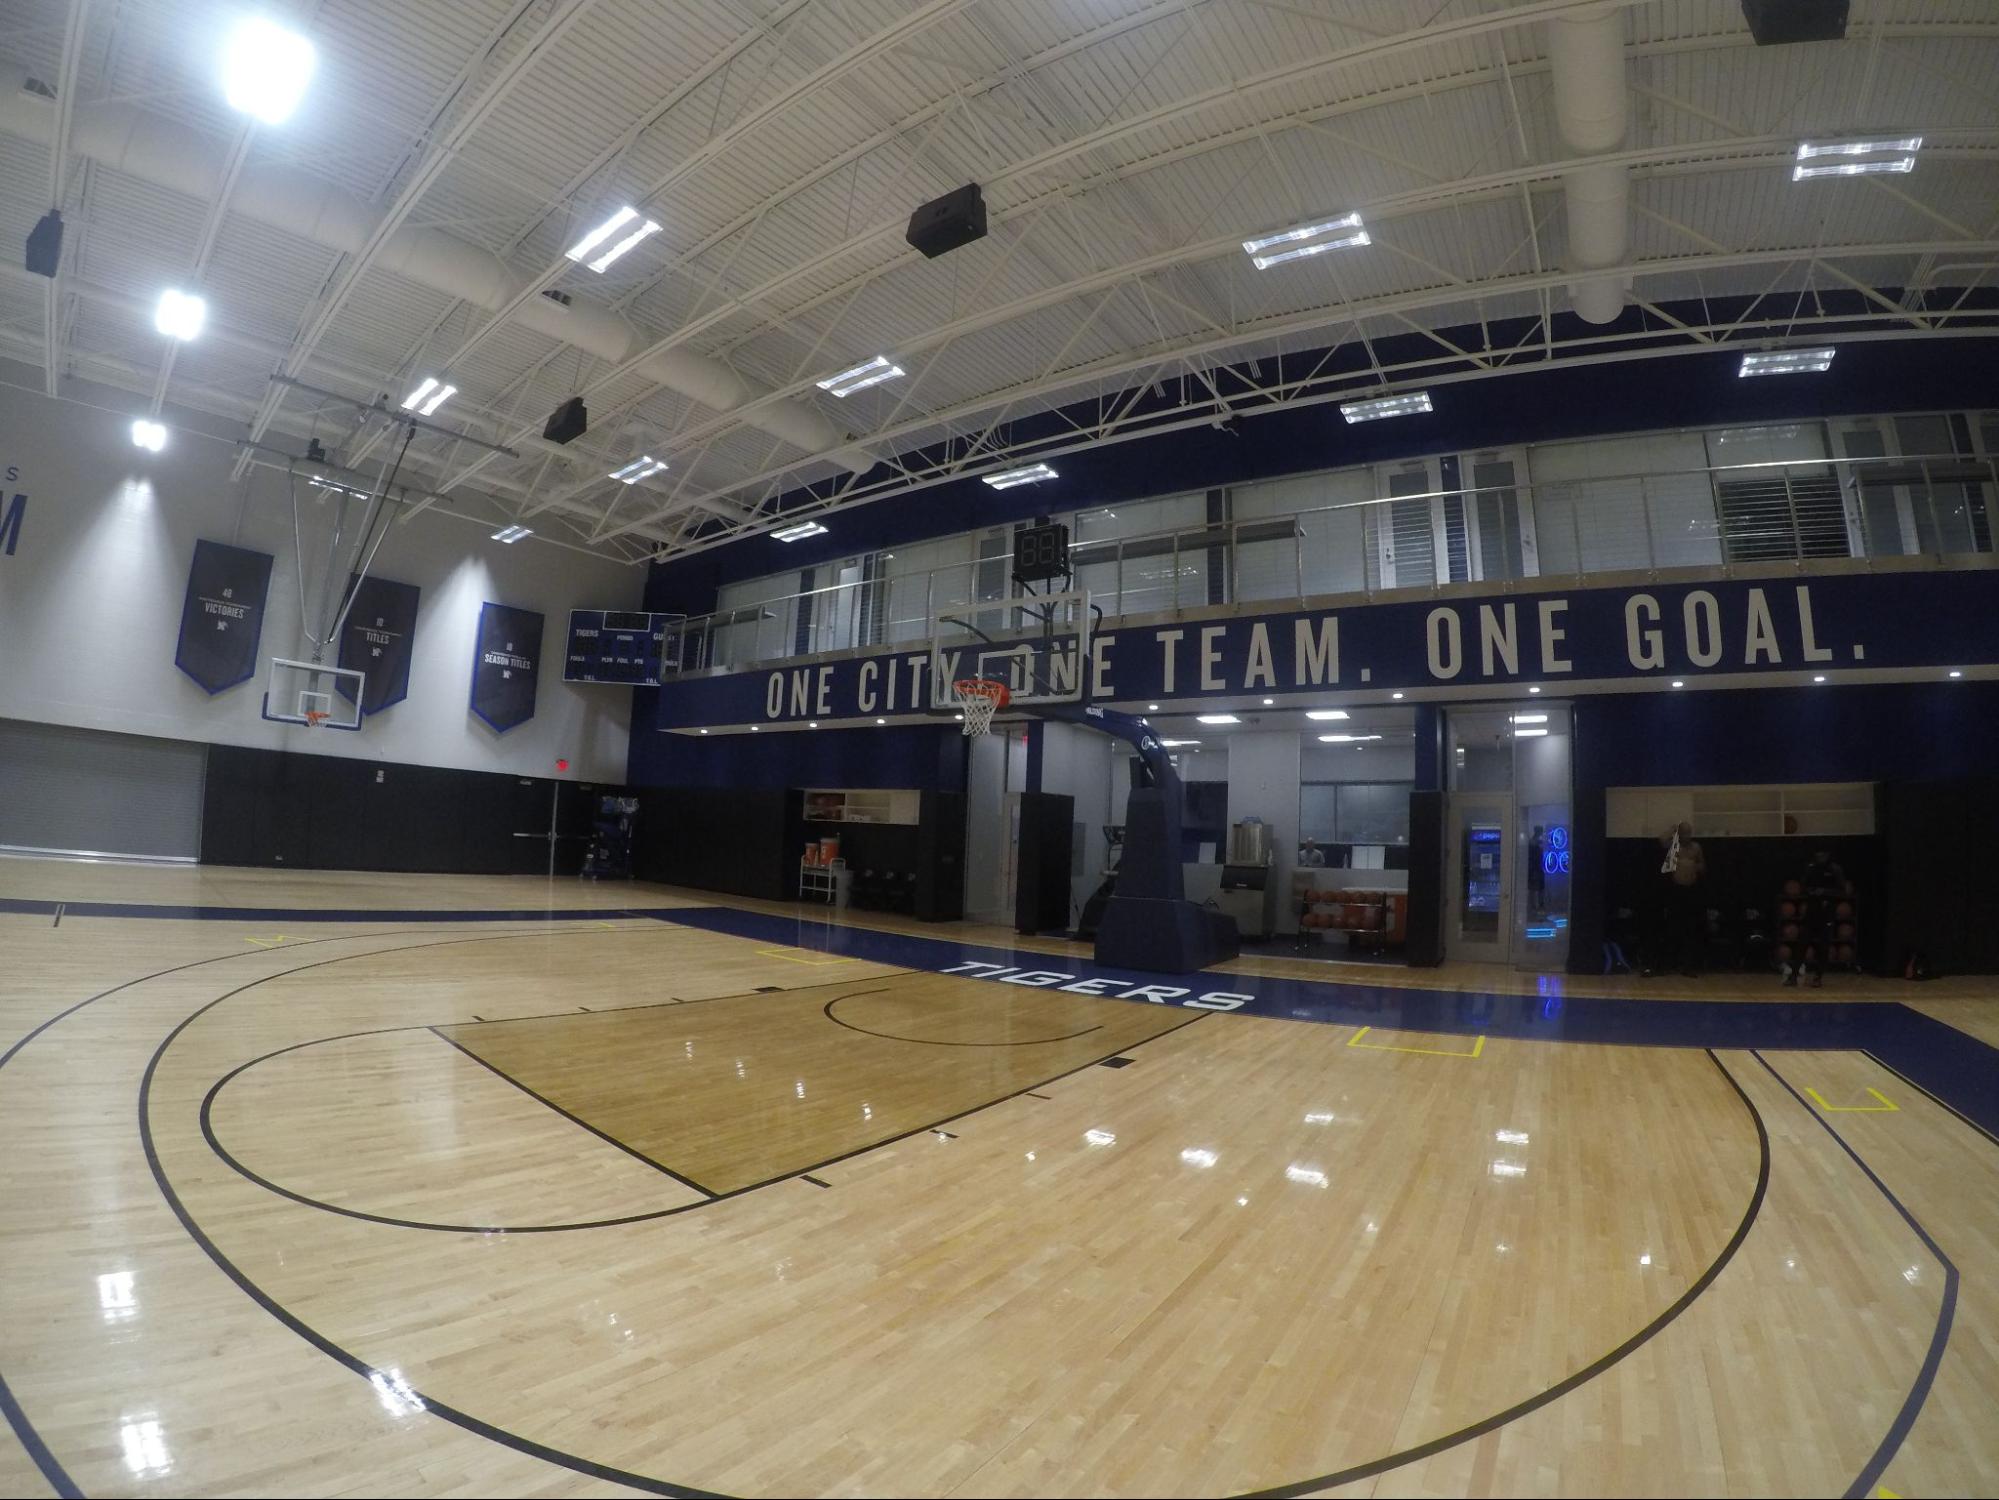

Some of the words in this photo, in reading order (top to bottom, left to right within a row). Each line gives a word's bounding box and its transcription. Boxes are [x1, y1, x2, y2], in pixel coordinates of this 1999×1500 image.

[204, 602, 244, 619] VICTORIES
[366, 632, 390, 644] TITLES
[576, 629, 599, 637] TIGERS
[767, 666, 834, 719] ONE
[1010, 636, 1116, 697] ONE
[1156, 617, 1371, 692] TEAM.
[1426, 600, 1572, 679] ONE
[1624, 586, 1865, 670] GOAL.
[484, 653, 509, 666] SEASON
[510, 658, 531, 670] TITLES
[940, 961, 1255, 1011] TIGERS
